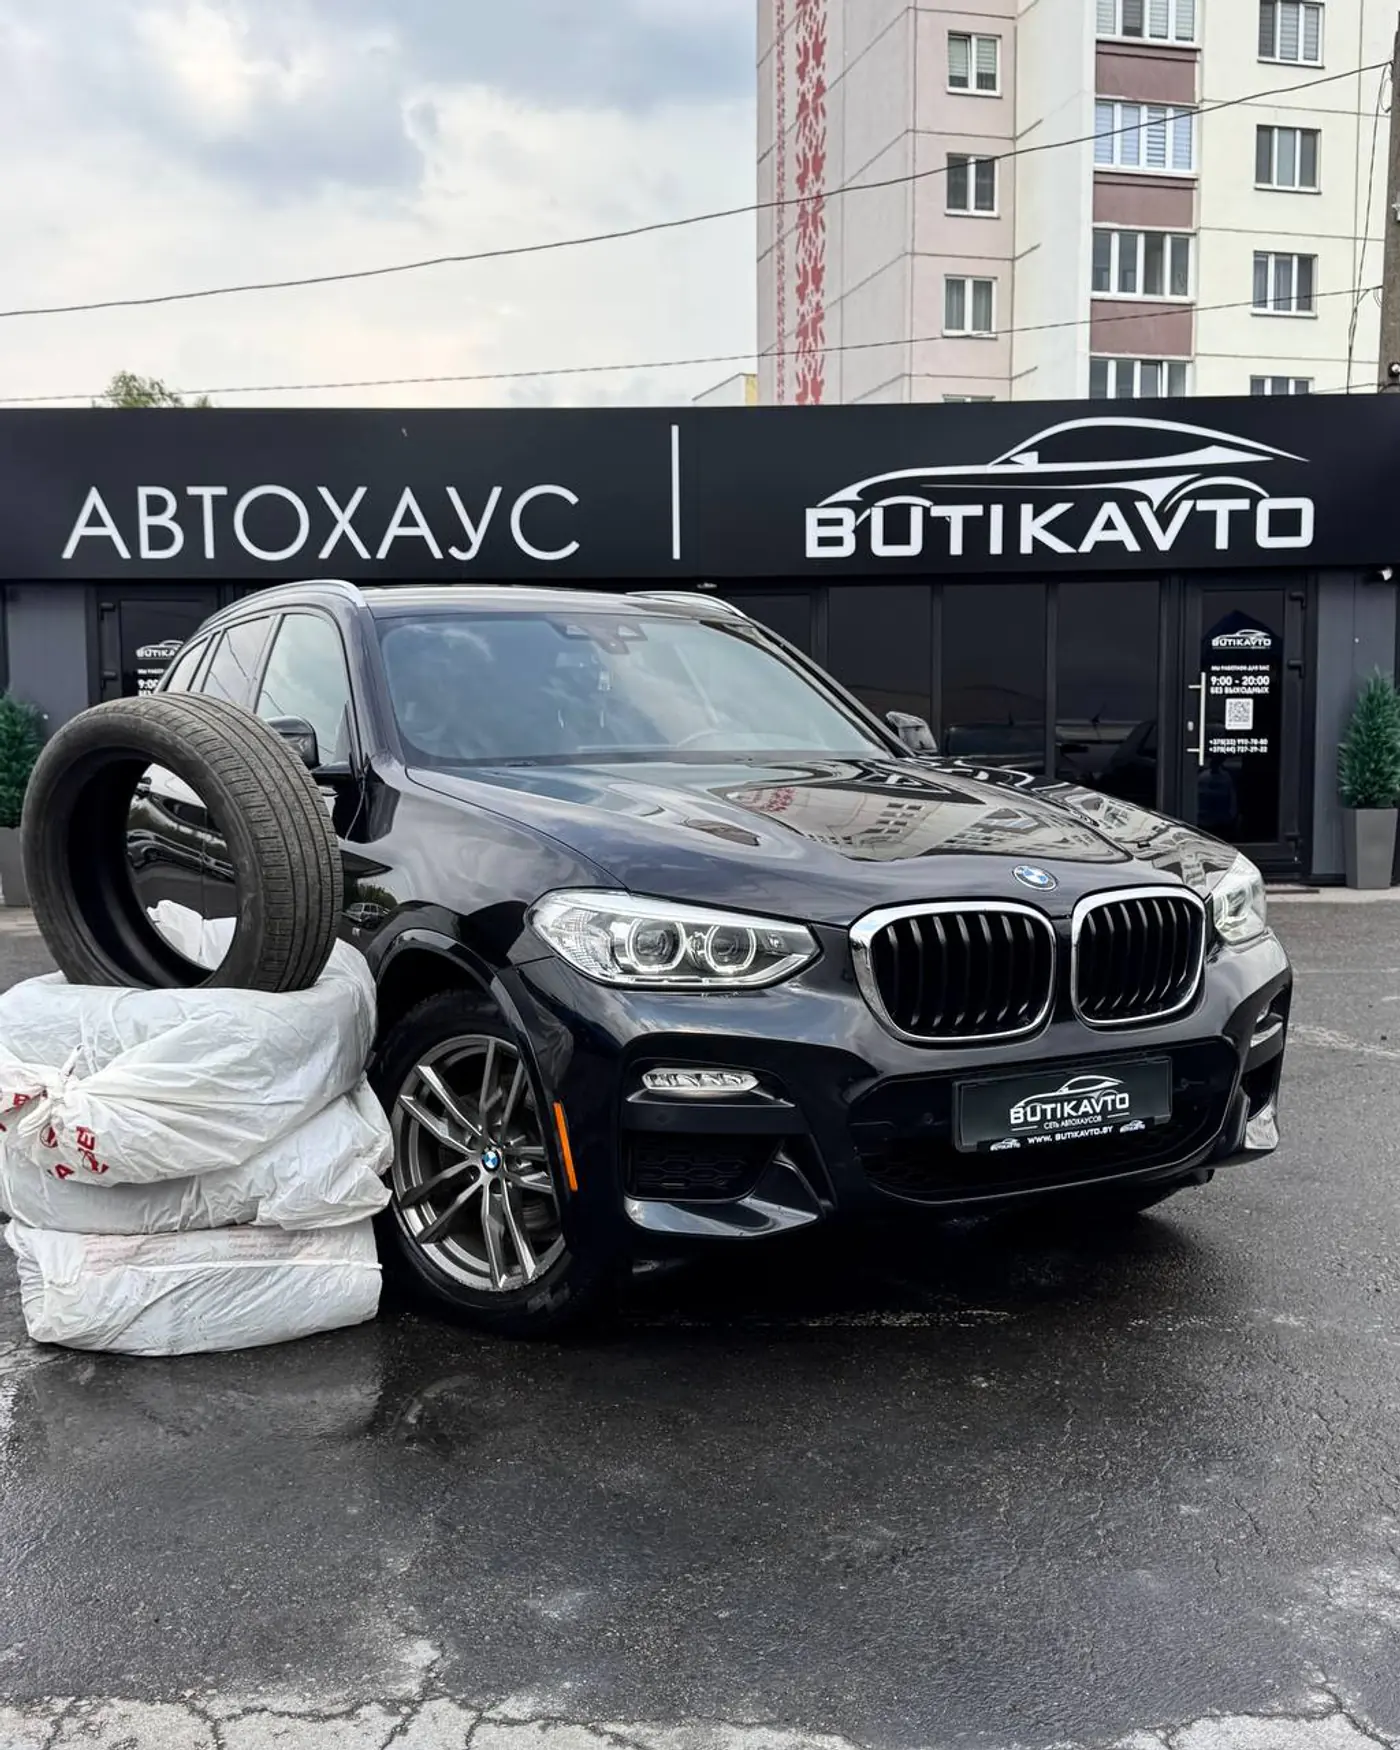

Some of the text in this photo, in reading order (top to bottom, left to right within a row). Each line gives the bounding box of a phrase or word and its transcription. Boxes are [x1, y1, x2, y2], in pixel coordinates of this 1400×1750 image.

[61, 484, 580, 560] АВТОХАУС
[805, 497, 1314, 557] BUTIKAVTO
[1211, 638, 1272, 647] BUTIKAVTO
[1211, 675, 1233, 686] 9:00
[1241, 675, 1270, 686] 20:00
[1010, 1093, 1130, 1124] BUTIKAVTO
[1044, 1115, 1102, 1130] СЕТЬ АВТОХАУСОВ
